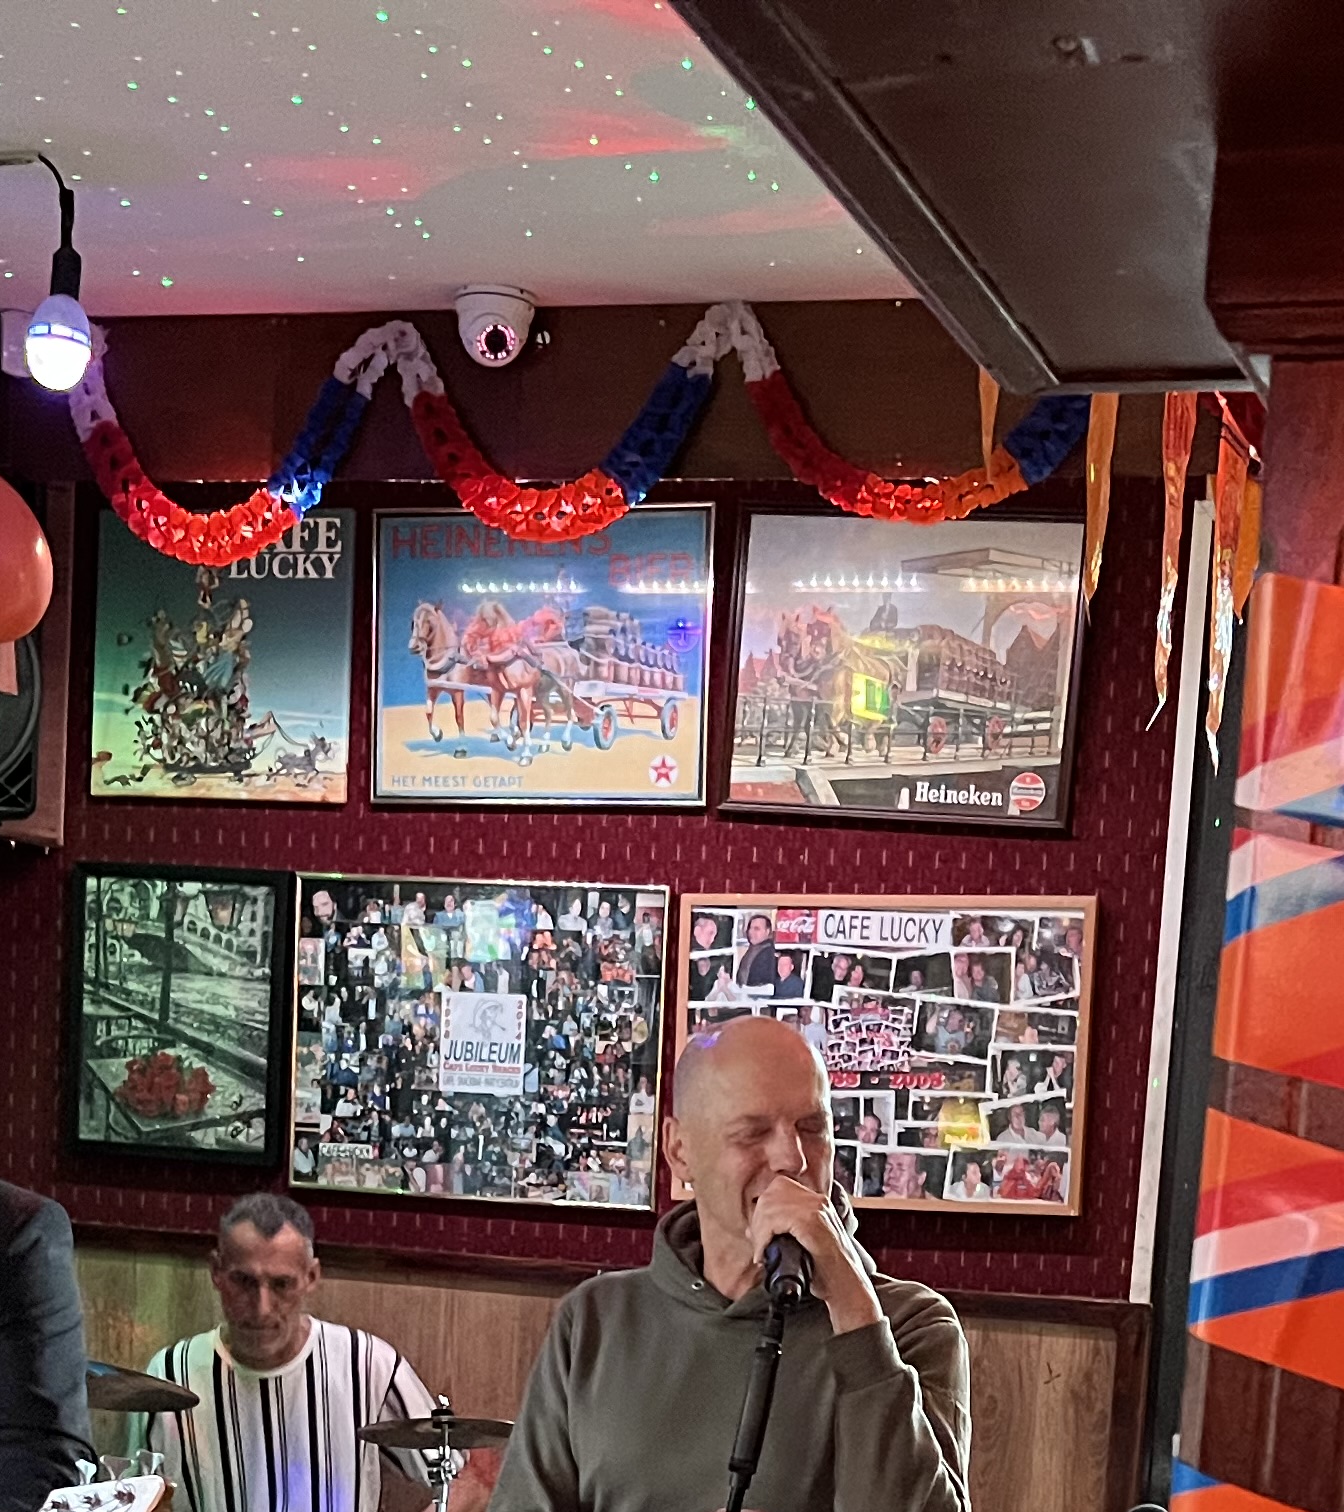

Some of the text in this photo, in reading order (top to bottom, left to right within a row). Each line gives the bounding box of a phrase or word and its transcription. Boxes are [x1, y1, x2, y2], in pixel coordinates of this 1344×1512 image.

[229, 553, 341, 579] LUCKY
[609, 552, 695, 586] BIER
[391, 775, 524, 789] HET MEEST GETAPT
[915, 781, 1003, 806] Heineken
[824, 914, 944, 943] CAFE LUCKY
[444, 1040, 521, 1064] JUBILEUM
